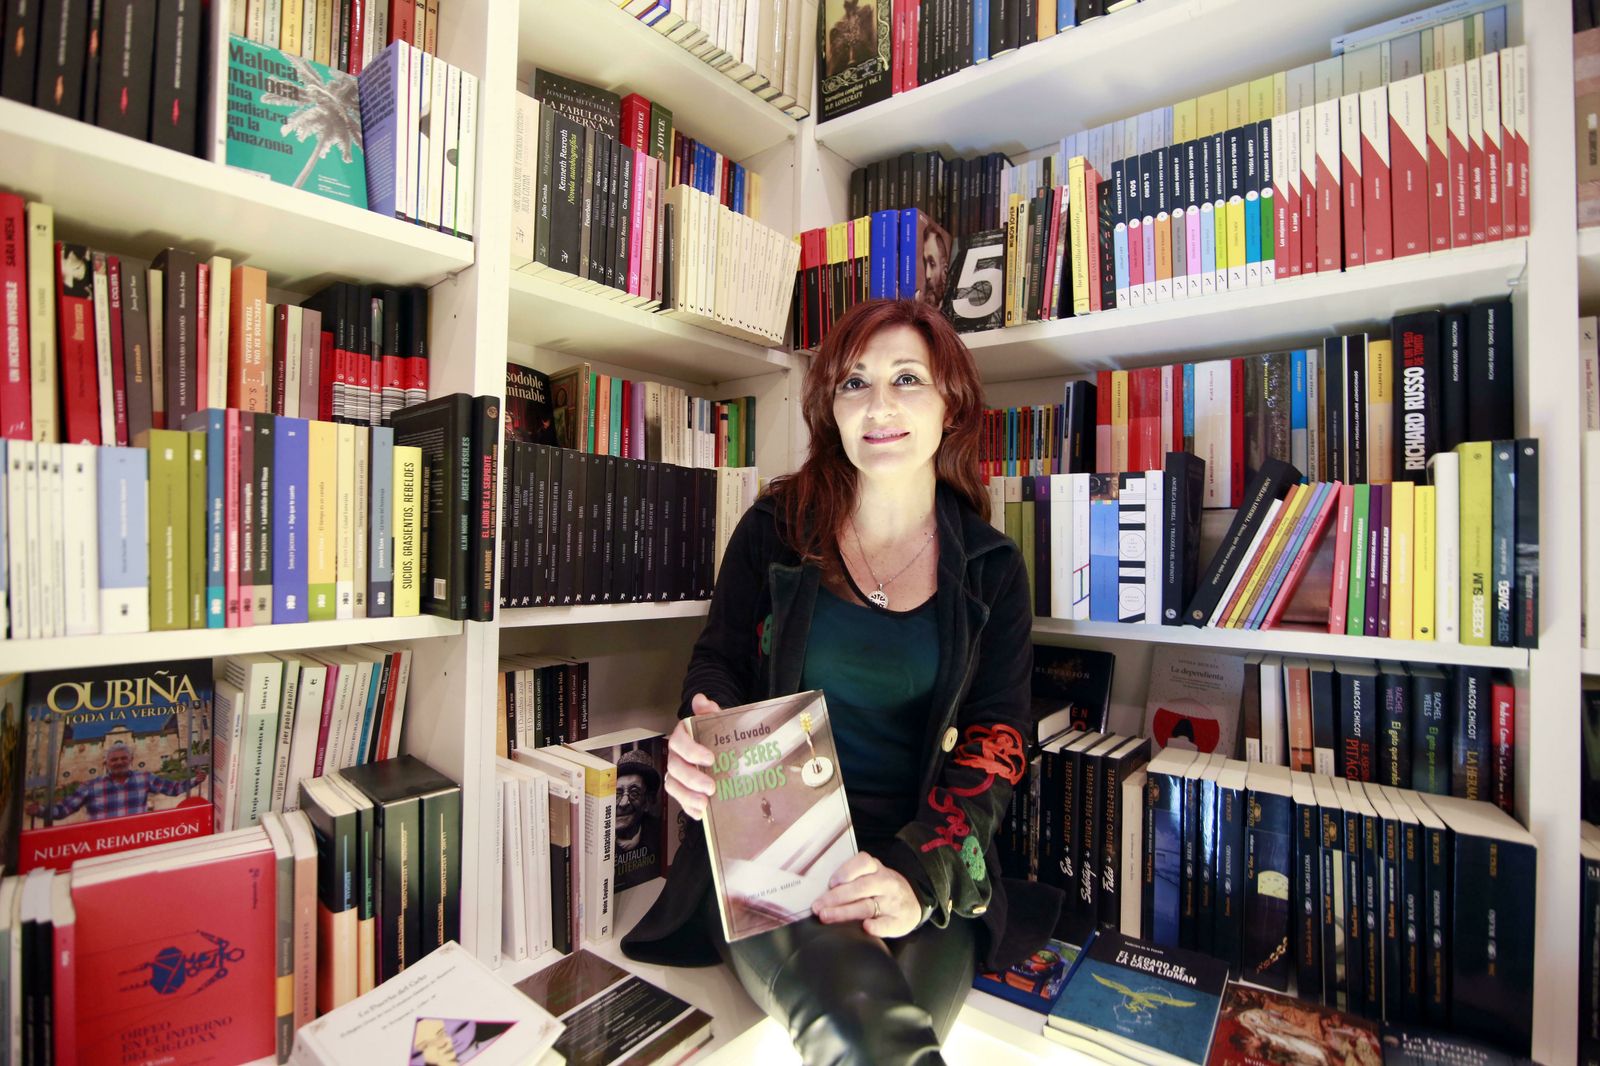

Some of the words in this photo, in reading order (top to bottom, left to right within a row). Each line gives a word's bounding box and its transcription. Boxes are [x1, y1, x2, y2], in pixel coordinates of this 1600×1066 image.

[229, 43, 304, 86] Maloca,
[227, 65, 299, 101] maloca
[228, 86, 252, 101] Una
[227, 100, 289, 126] pediatra
[227, 114, 244, 127] en
[247, 118, 260, 131] la
[558, 102, 615, 127] FABULOSA
[637, 111, 645, 133] JOYCE
[227, 123, 293, 155] Amazonia
[560, 129, 568, 159] Rexroth
[657, 118, 666, 150] JOYCE
[569, 133, 578, 180] autobiográfica
[558, 160, 568, 191] Kenneth
[568, 182, 576, 204] Novela
[584, 198, 592, 227] Feuerbach
[5, 217, 14, 241] MESA
[6, 244, 16, 267] SARA
[953, 243, 1004, 319] 5
[6, 281, 18, 325] INVISIBLE
[7, 326, 19, 367] INCENDIO
[254, 338, 261, 348] EN
[1414, 334, 1423, 356] TONTO
[1415, 357, 1424, 366] DE
[9, 369, 20, 382] UN
[1404, 366, 1425, 410] RUSSO
[460, 436, 469, 467] FÓSILES
[1404, 412, 1426, 470] RICHARD
[403, 462, 414, 502] REBELDES
[460, 468, 469, 501] ÁNGELES
[483, 455, 492, 489] SERPIENTE
[483, 491, 491, 499] LA
[402, 505, 415, 557] GRASIENTOS,
[482, 509, 490, 529] LIBRO
[481, 530, 490, 538] EL
[402, 558, 414, 589] SUCIOS,
[484, 550, 492, 572] MOORE
[484, 573, 492, 589] ALAN
[1035, 666, 1090, 680] ELEVACIÓN
[1171, 665, 1180, 673] La
[1179, 667, 1224, 682] dependienta
[46, 670, 201, 714] OUBIÑA
[285, 682, 295, 709] pasolini
[1352, 680, 1361, 710] MARCOS
[1385, 687, 1395, 711] WELLS
[1394, 686, 1403, 714] RACHEL
[1467, 677, 1476, 710] MARCOS
[65, 713, 106, 725] TODA
[110, 711, 127, 720] LA
[131, 705, 187, 718] VERDAD
[1423, 694, 1432, 717] WELLS
[1432, 692, 1442, 720] RACHEL
[283, 711, 292, 731] paolo
[1353, 711, 1362, 737] CHICOT
[1390, 721, 1401, 729] El
[1468, 711, 1476, 739] CHICOT
[282, 732, 290, 745] pier
[714, 732, 730, 746] Jes
[733, 723, 771, 742] Lavado
[1388, 730, 1400, 745] gato
[255, 733, 266, 765] presidente
[712, 751, 740, 774] LOS
[744, 741, 783, 767] SERES
[1389, 747, 1398, 760] que
[1466, 751, 1479, 765] LA
[715, 766, 788, 801] INÉDITOS
[1063, 761, 1073, 812] PÉREZ-REVERTE
[1390, 762, 1400, 785] curaba
[275, 779, 285, 801] vulgar
[1083, 764, 1094, 817] PÉREZ-REVERTE
[1106, 768, 1115, 822] PÉREZ-REVERTE
[603, 816, 612, 825] del
[604, 805, 612, 815] caos
[34, 842, 92, 862] NUEVA
[96, 821, 200, 851] REIMPRESIÓN
[603, 826, 612, 852] estación
[1064, 814, 1072, 843] ARTURO
[1085, 819, 1093, 848] ARTURO
[1106, 824, 1114, 854] ARTURO
[603, 853, 611, 861] La
[1060, 856, 1073, 877] Eva
[602, 878, 610, 898] Soyinka
[1115, 956, 1129, 966] LA
[1130, 959, 1156, 974] CASA
[1157, 965, 1198, 985] LIDMAN
[1118, 950, 1130, 960] EL
[1132, 952, 1171, 970] LEGADO
[1171, 964, 1187, 975] DE
